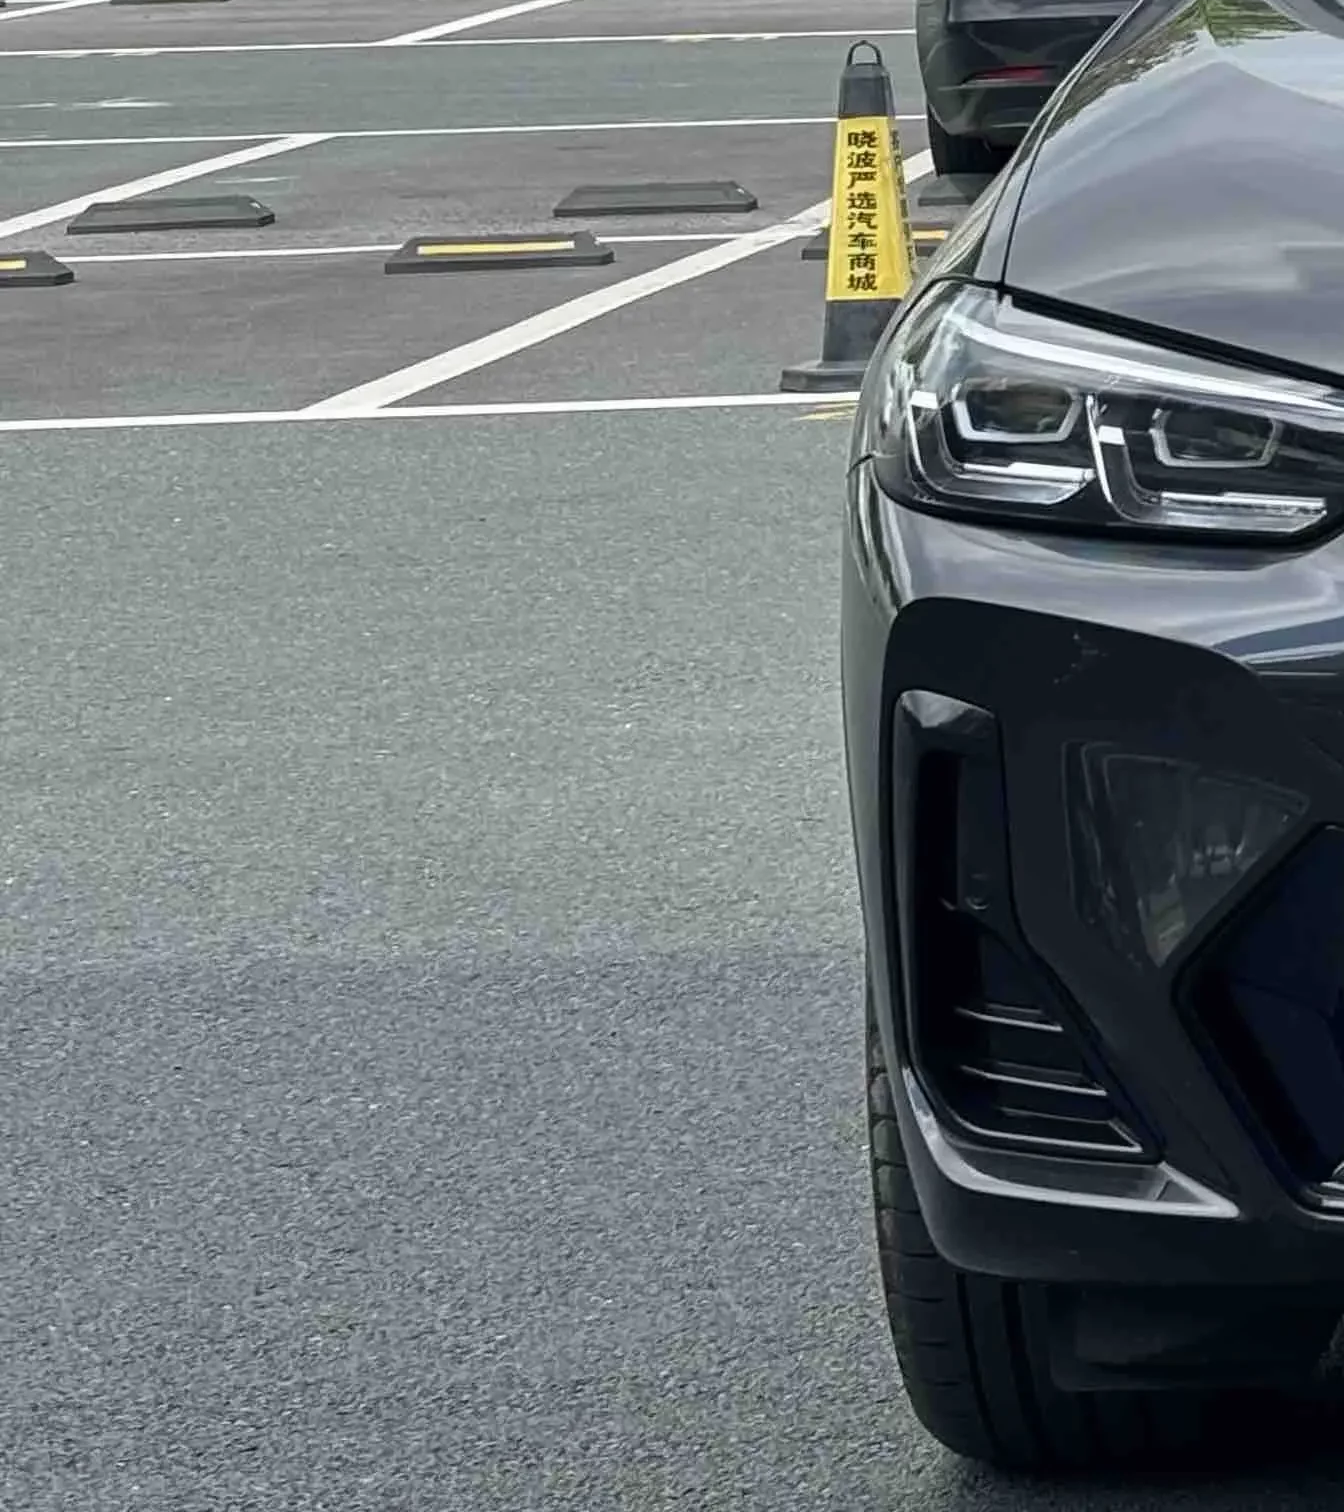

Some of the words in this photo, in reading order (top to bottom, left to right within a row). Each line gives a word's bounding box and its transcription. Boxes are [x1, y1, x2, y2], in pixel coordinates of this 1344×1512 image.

[847, 130, 878, 291] 晓波严选汽车商城
